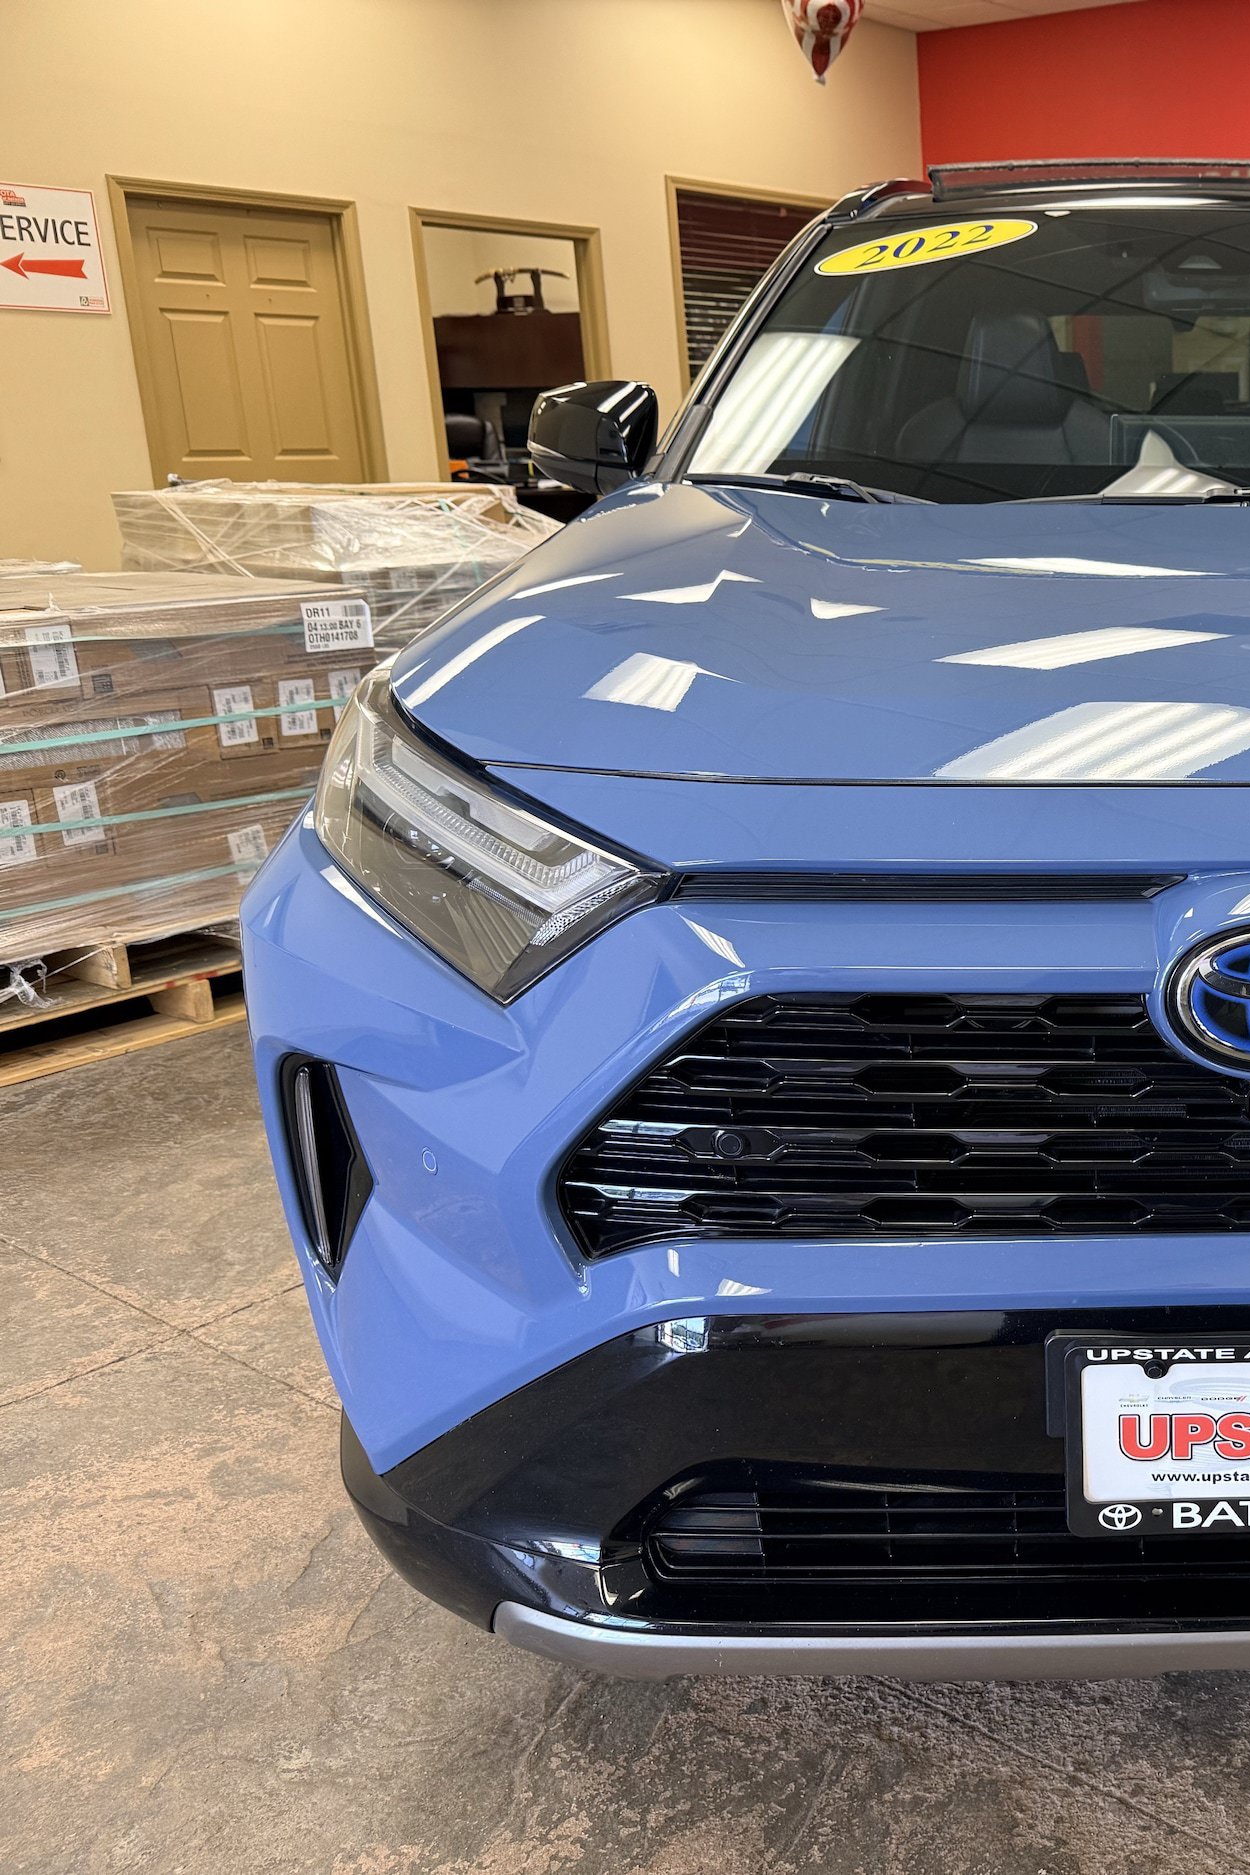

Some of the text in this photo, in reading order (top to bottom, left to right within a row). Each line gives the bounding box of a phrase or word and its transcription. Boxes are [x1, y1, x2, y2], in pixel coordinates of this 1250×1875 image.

[855, 225, 994, 269] 2022
[305, 607, 330, 618] DR11
[1086, 1348, 1235, 1361] UPSTATE
